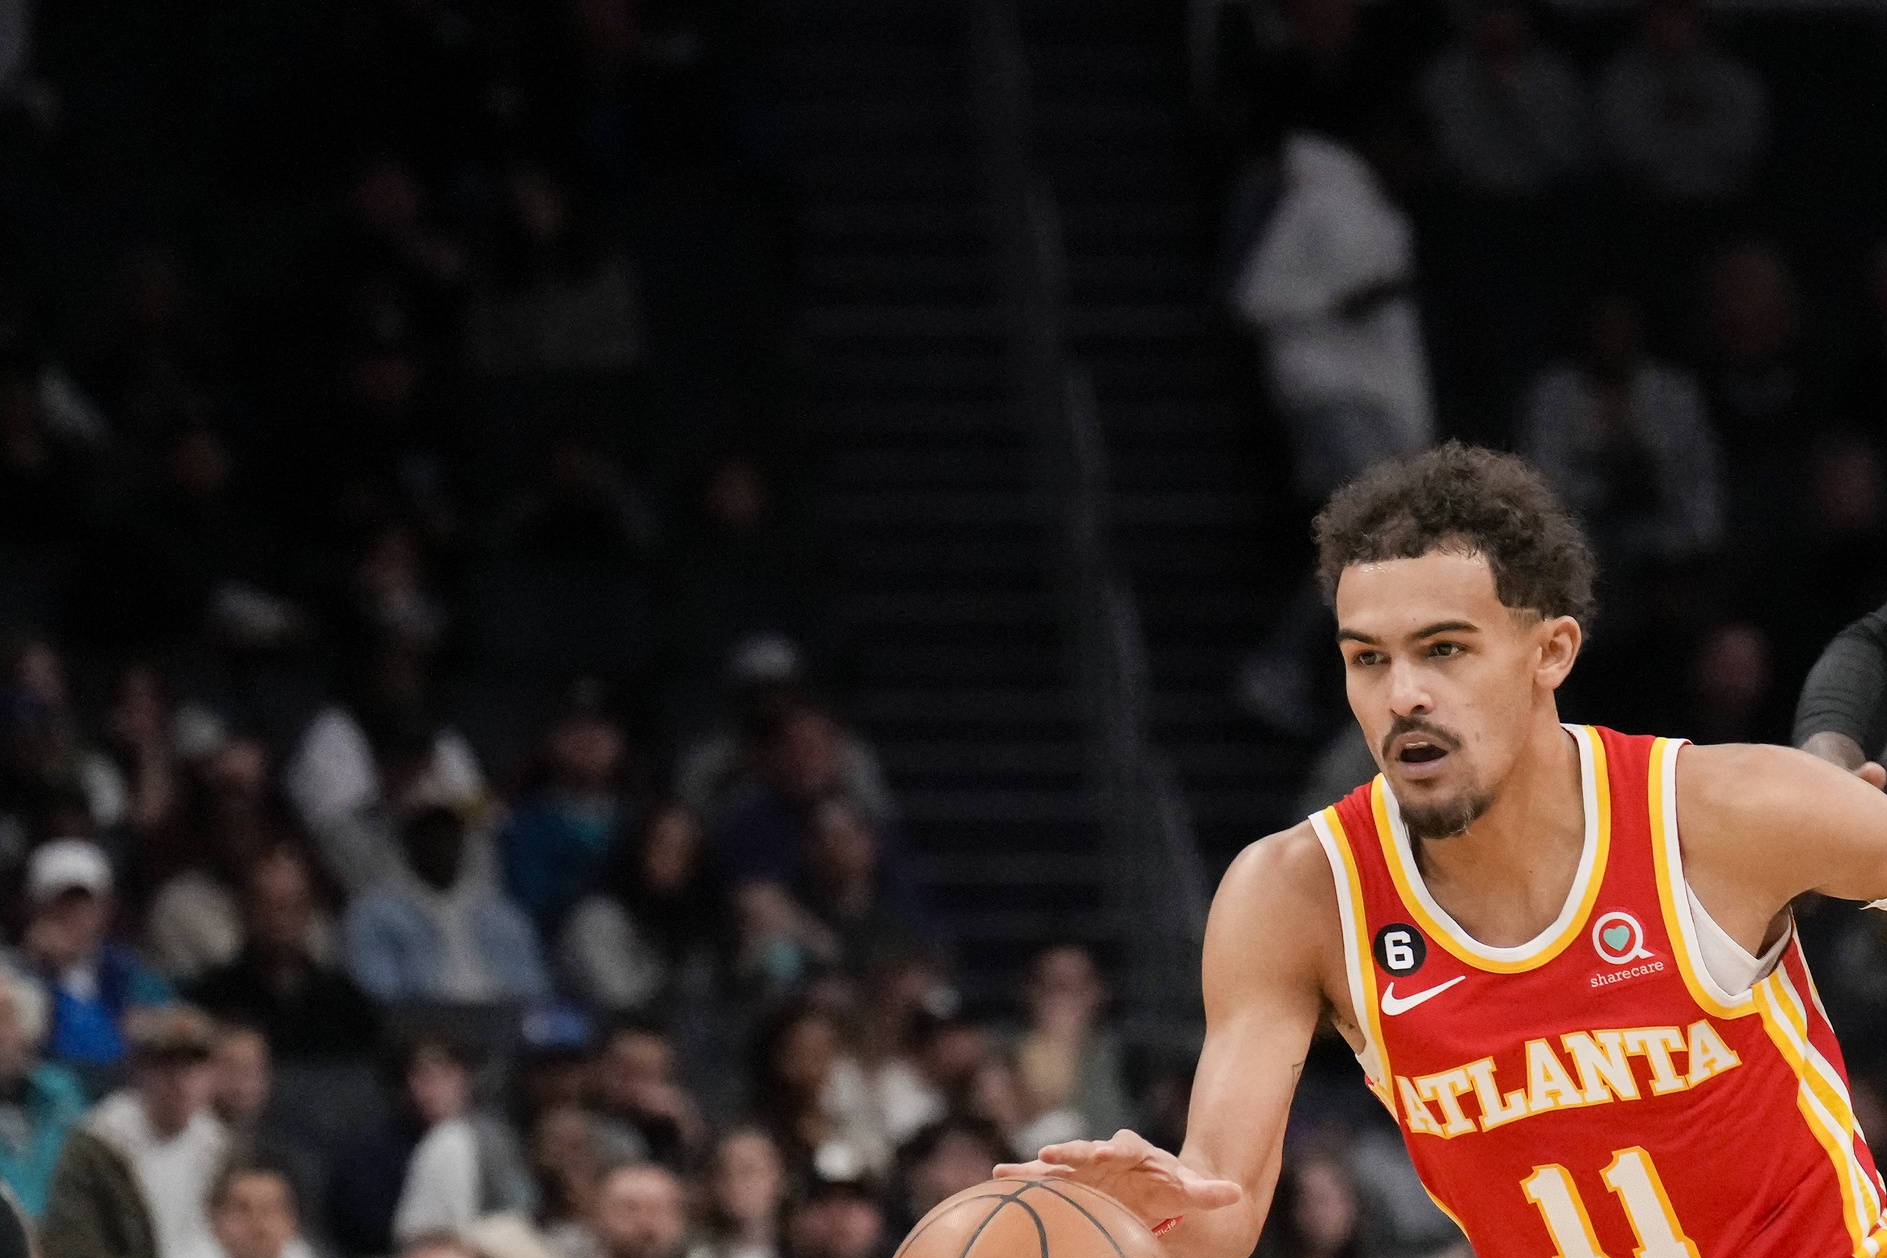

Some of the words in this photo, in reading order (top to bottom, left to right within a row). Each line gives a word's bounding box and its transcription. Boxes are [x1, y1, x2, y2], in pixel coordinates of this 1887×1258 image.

[1384, 931, 1412, 970] 6
[1590, 961, 1664, 988] sharecare
[1394, 1019, 1742, 1139] ATLANTA
